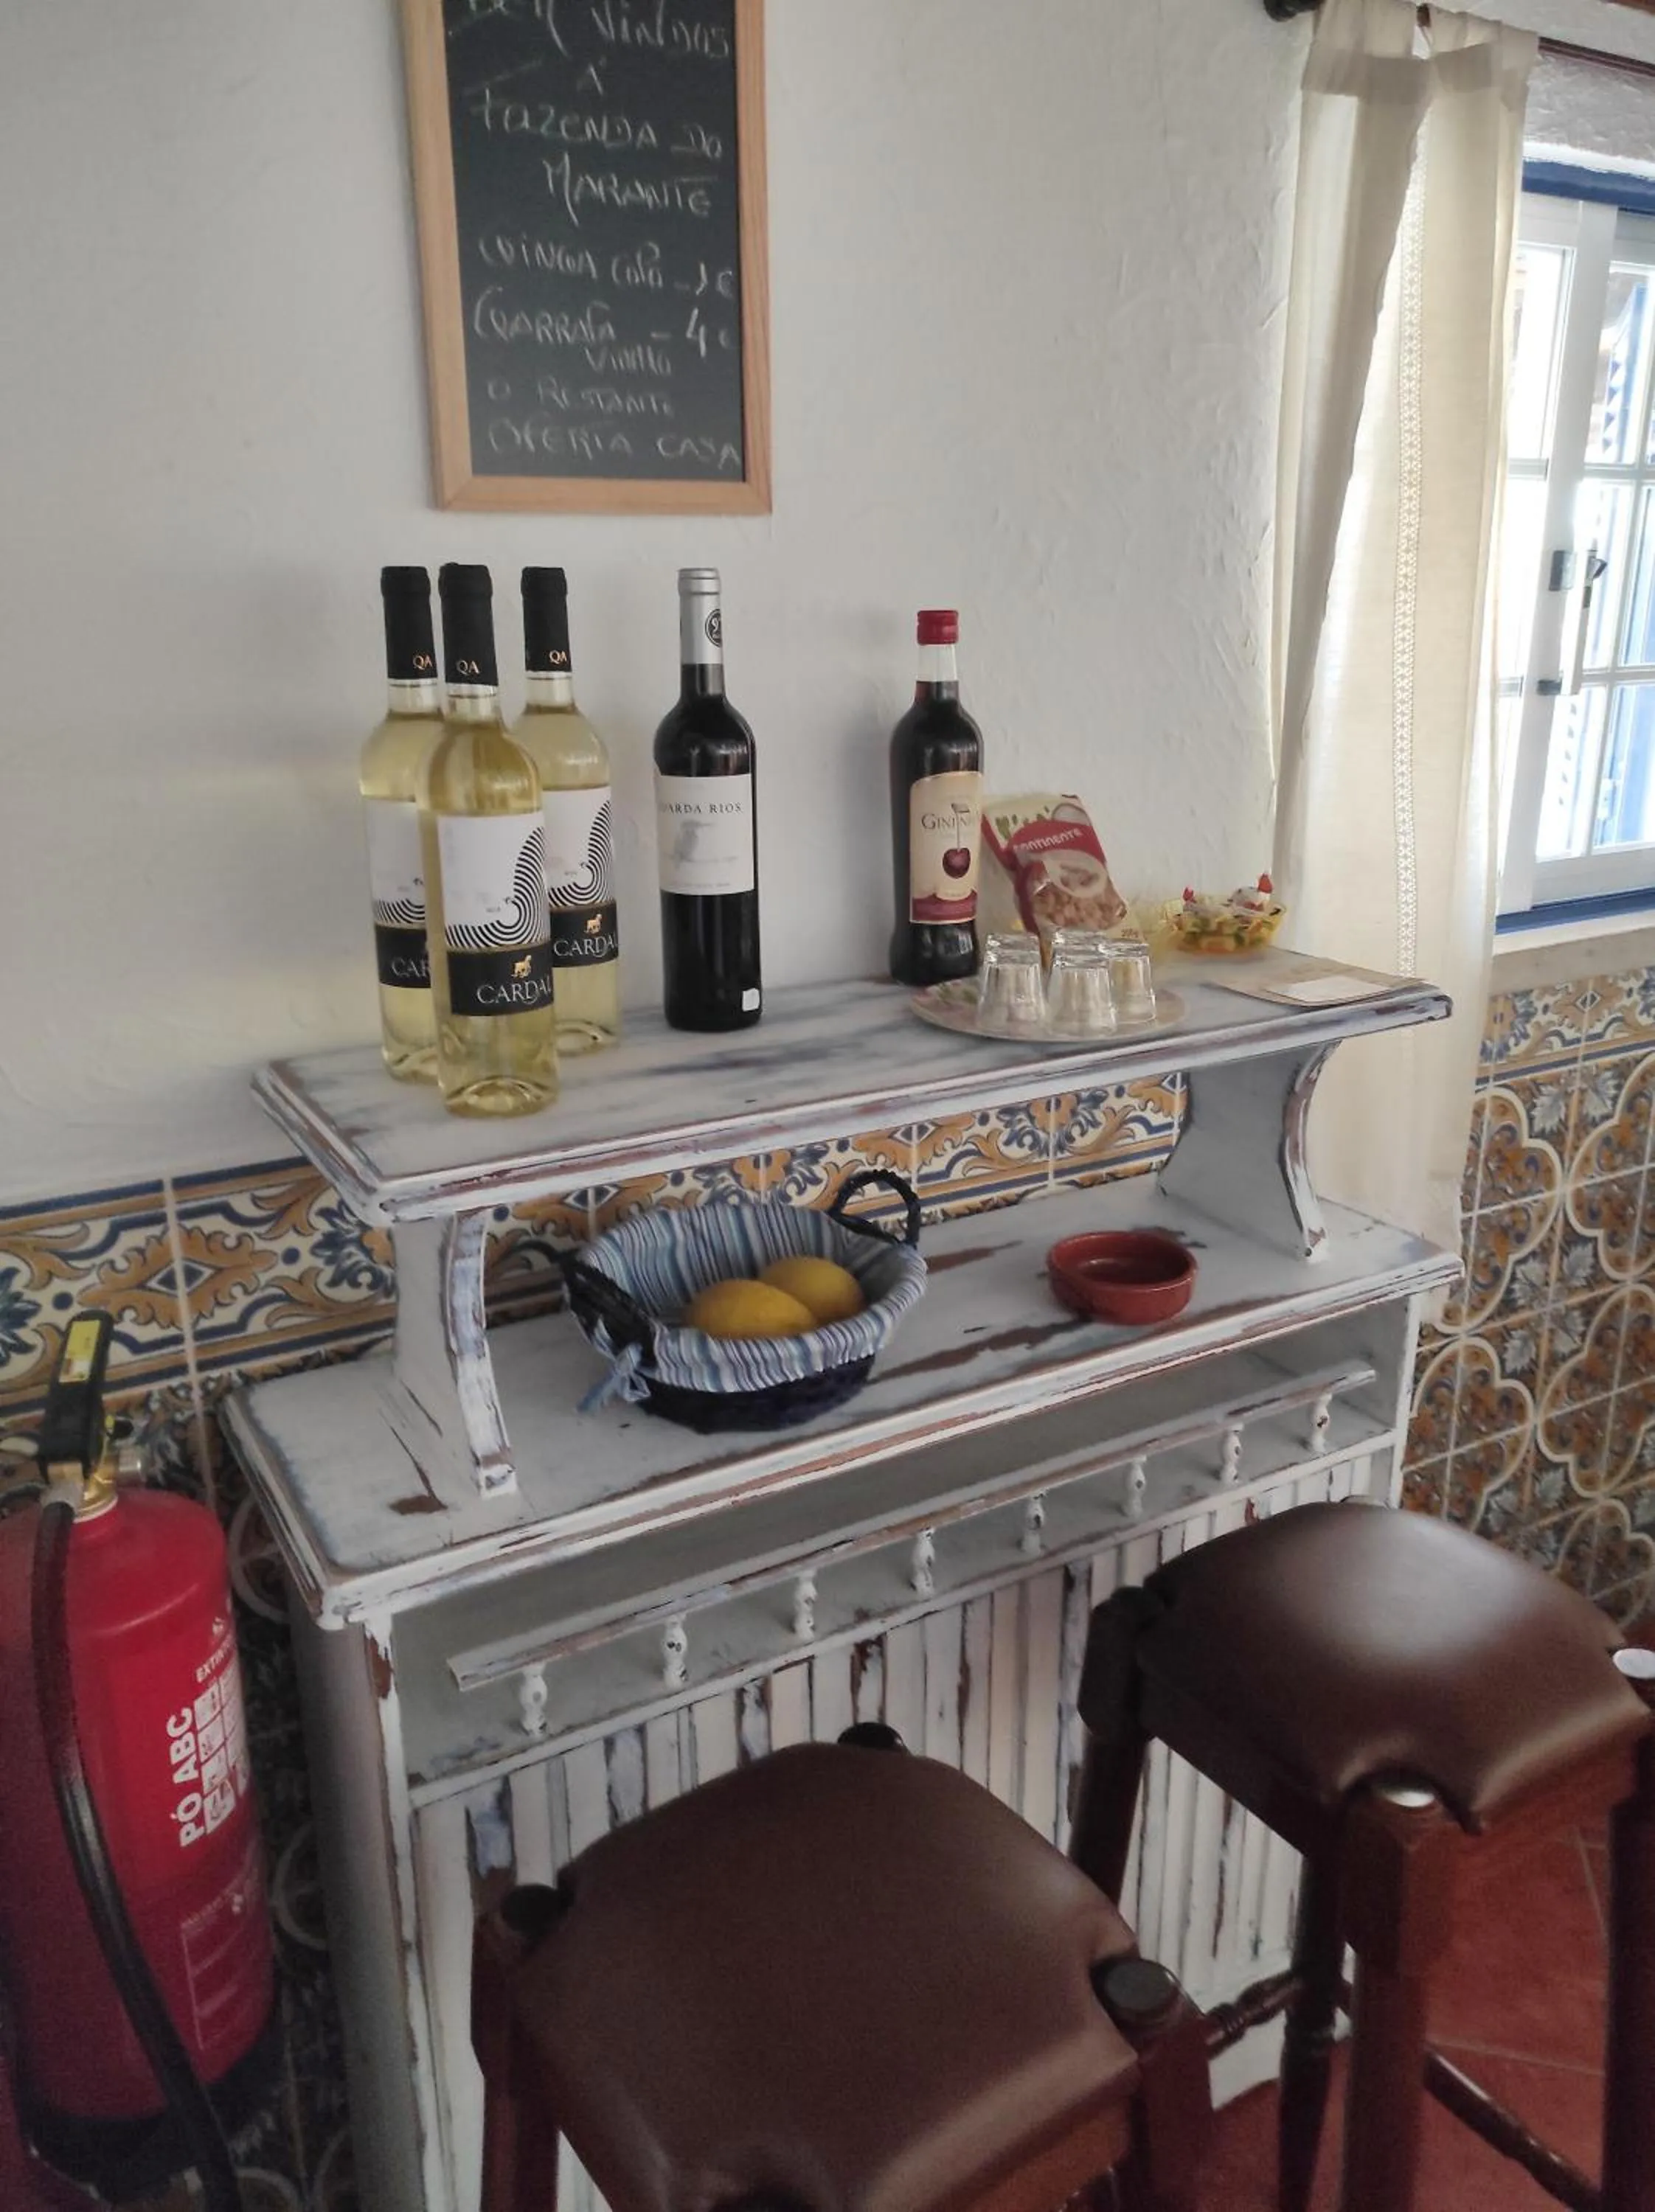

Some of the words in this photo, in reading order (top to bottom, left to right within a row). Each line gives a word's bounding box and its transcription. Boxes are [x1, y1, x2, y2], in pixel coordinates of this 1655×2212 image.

[457, 659, 479, 676] QA
[709, 801, 743, 814] RIOS
[166, 1706, 200, 1784] ABC
